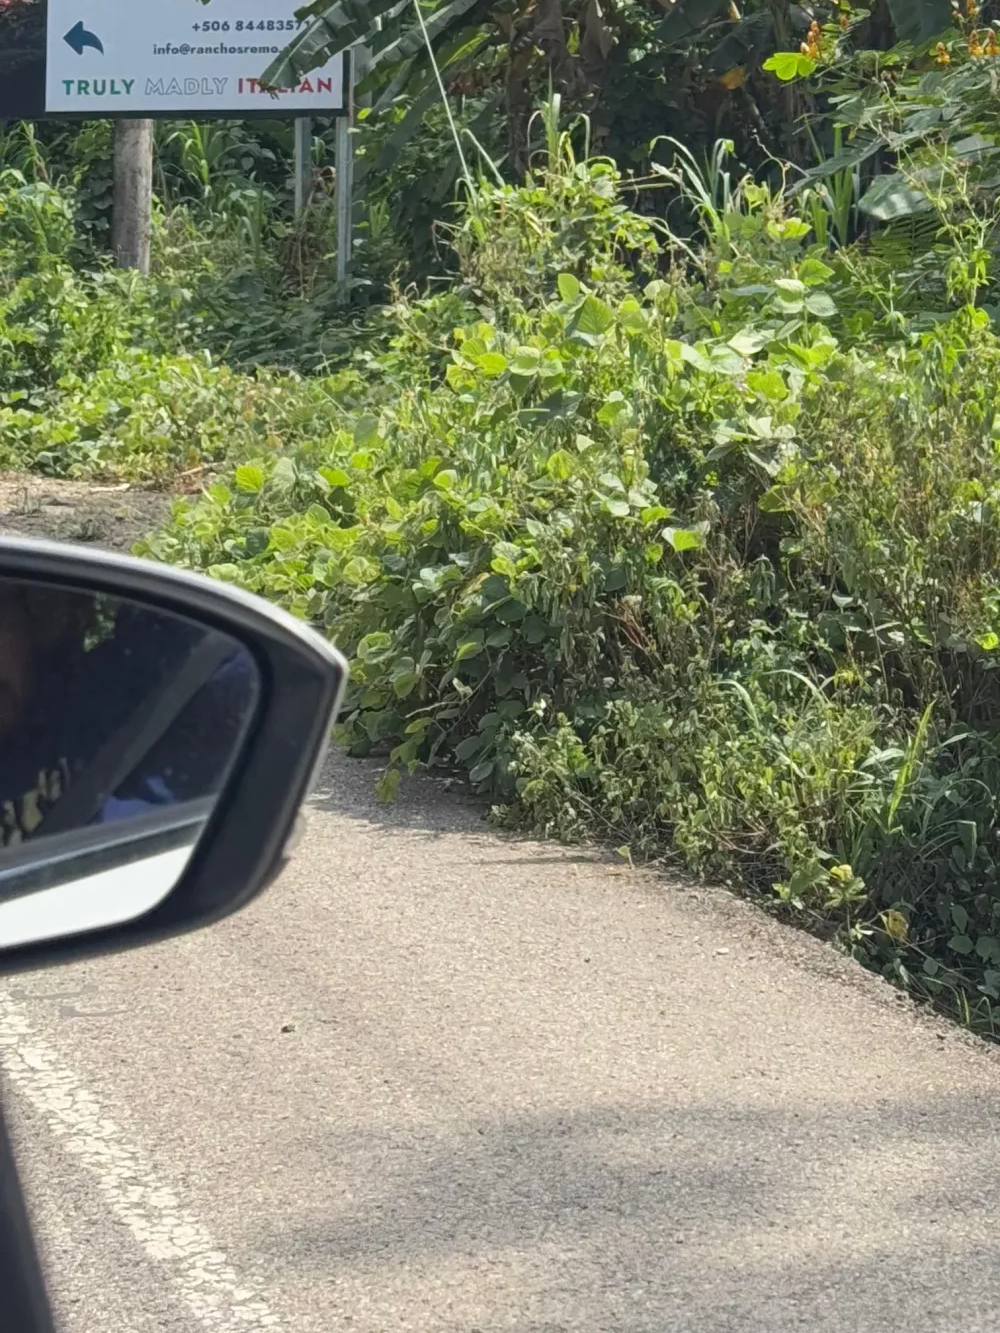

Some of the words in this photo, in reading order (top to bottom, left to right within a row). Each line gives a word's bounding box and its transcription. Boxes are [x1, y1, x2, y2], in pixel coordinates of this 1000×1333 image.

[192, 20, 231, 32] +506
[62, 78, 136, 96] TRULY
[144, 77, 229, 96] MADLY
[238, 77, 332, 94] ITAN
